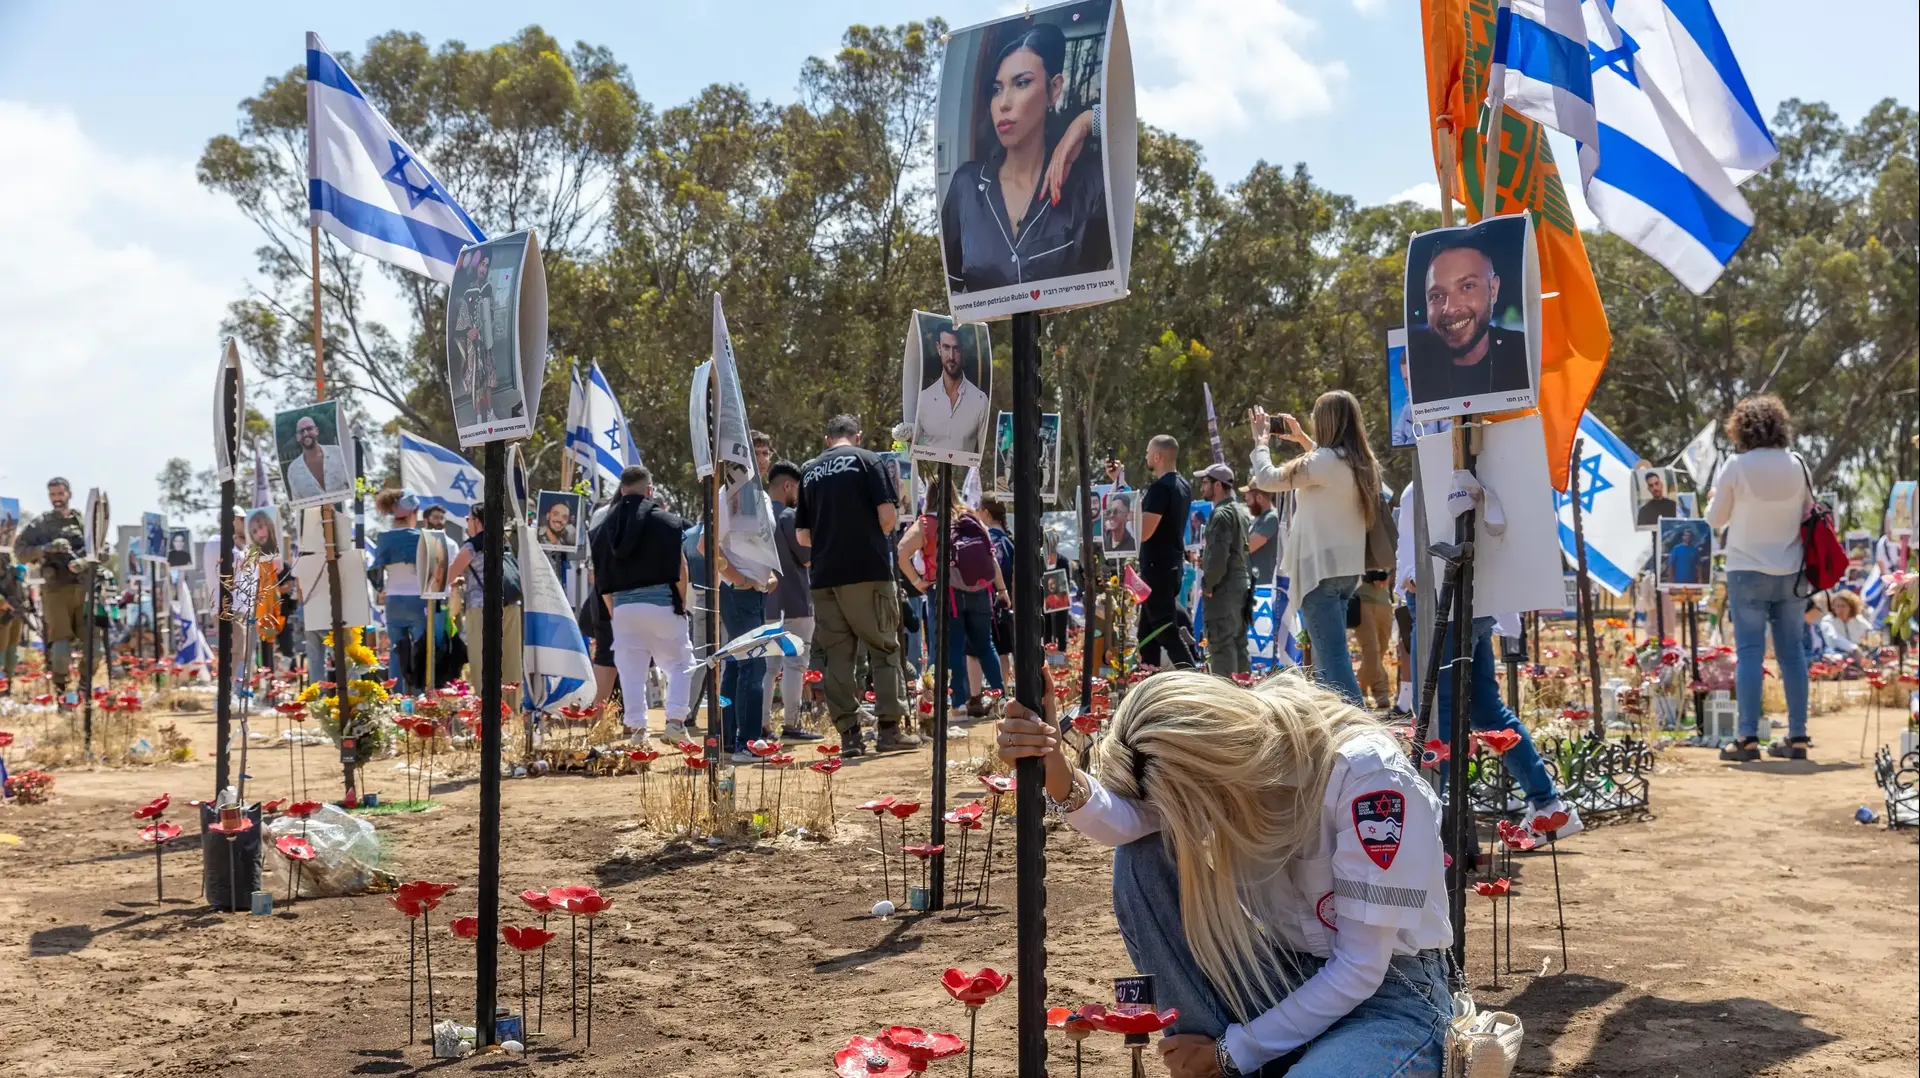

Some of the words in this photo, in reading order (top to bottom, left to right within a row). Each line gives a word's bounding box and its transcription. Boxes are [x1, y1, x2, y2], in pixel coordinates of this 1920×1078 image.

[1086, 282, 1098, 291] עדן
[1098, 280, 1115, 288] איבון
[954, 303, 973, 312] Ivonne
[973, 300, 986, 308] Eden
[987, 296, 1010, 307] patricia
[1011, 292, 1029, 301] Rubio
